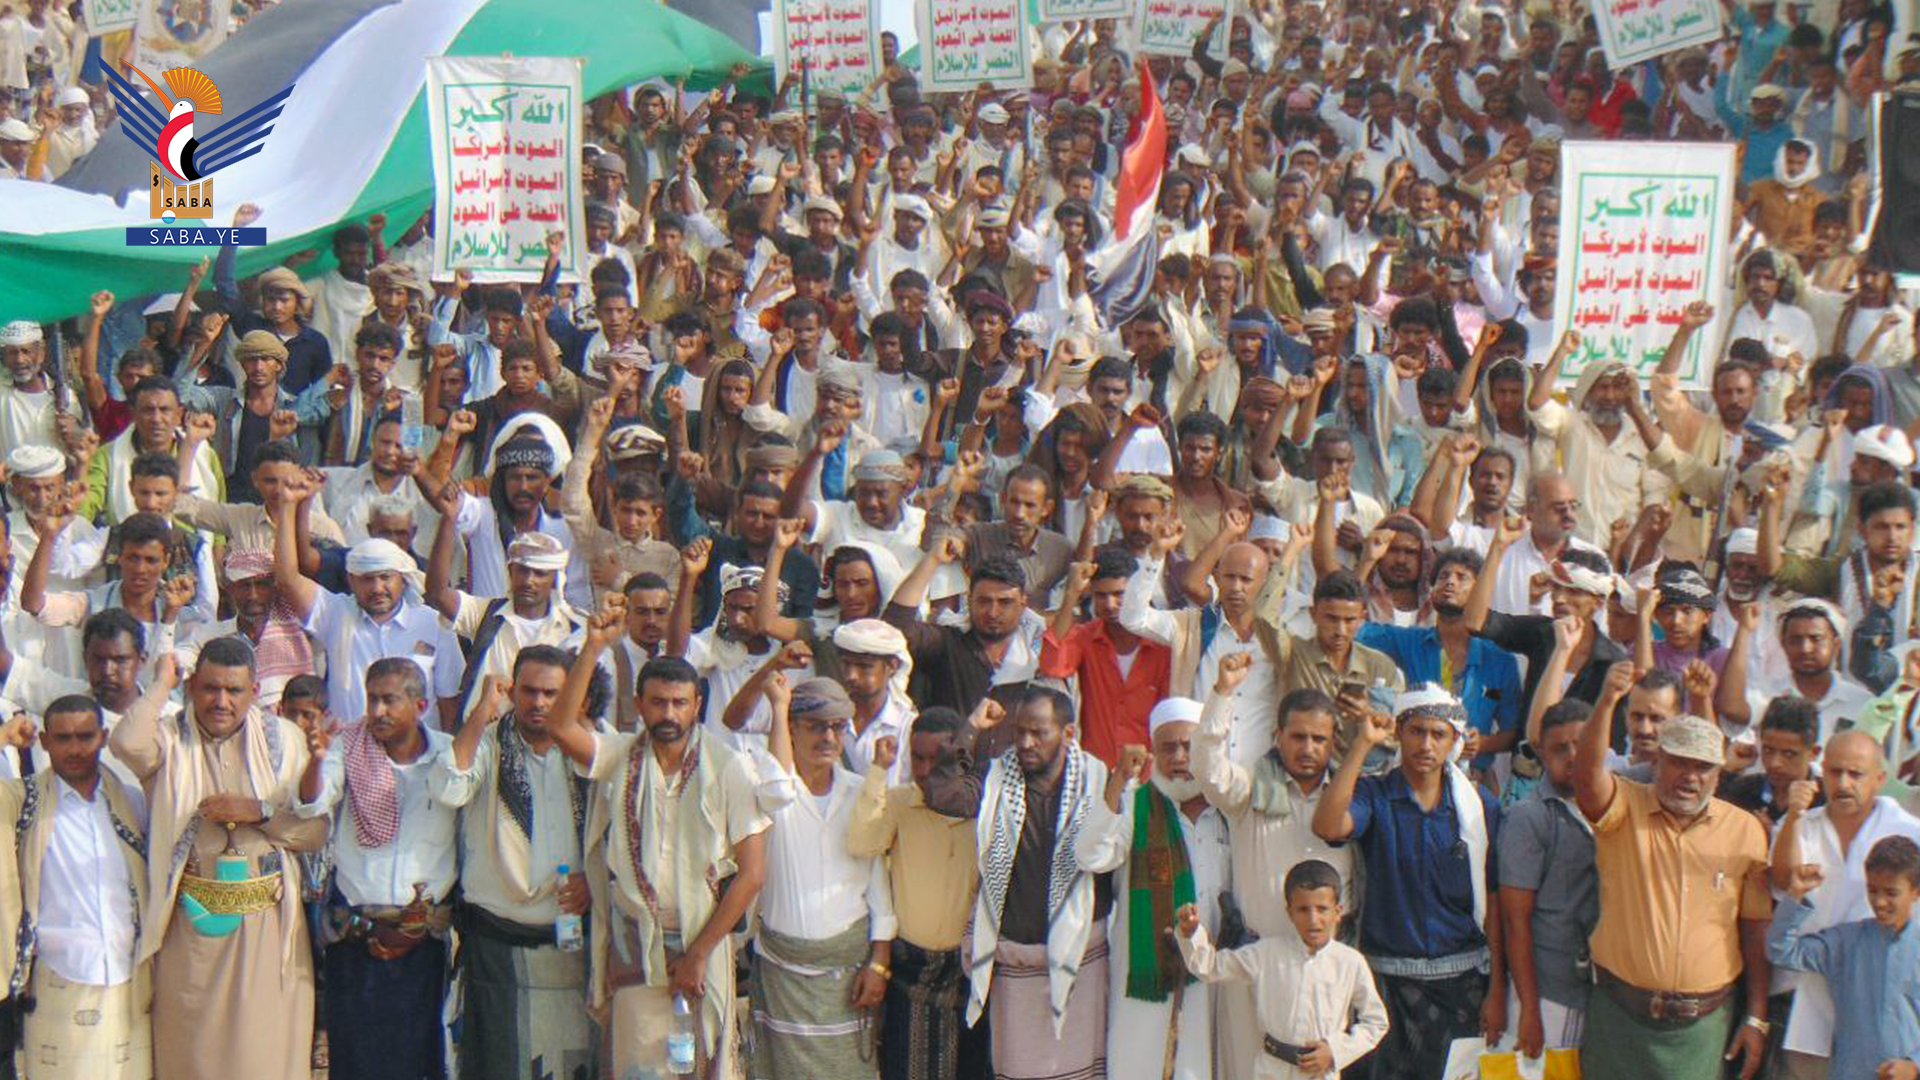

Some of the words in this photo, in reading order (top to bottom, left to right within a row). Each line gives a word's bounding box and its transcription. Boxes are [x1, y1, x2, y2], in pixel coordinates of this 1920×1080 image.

[452, 88, 520, 133] أكبر
[515, 137, 563, 164] الموت
[515, 171, 563, 194] الموت
[453, 201, 494, 226] اليهود
[526, 202, 565, 222] اللعنة
[1585, 179, 1661, 227] أكبر
[1652, 234, 1706, 258] الموت
[1648, 268, 1702, 294] الموت
